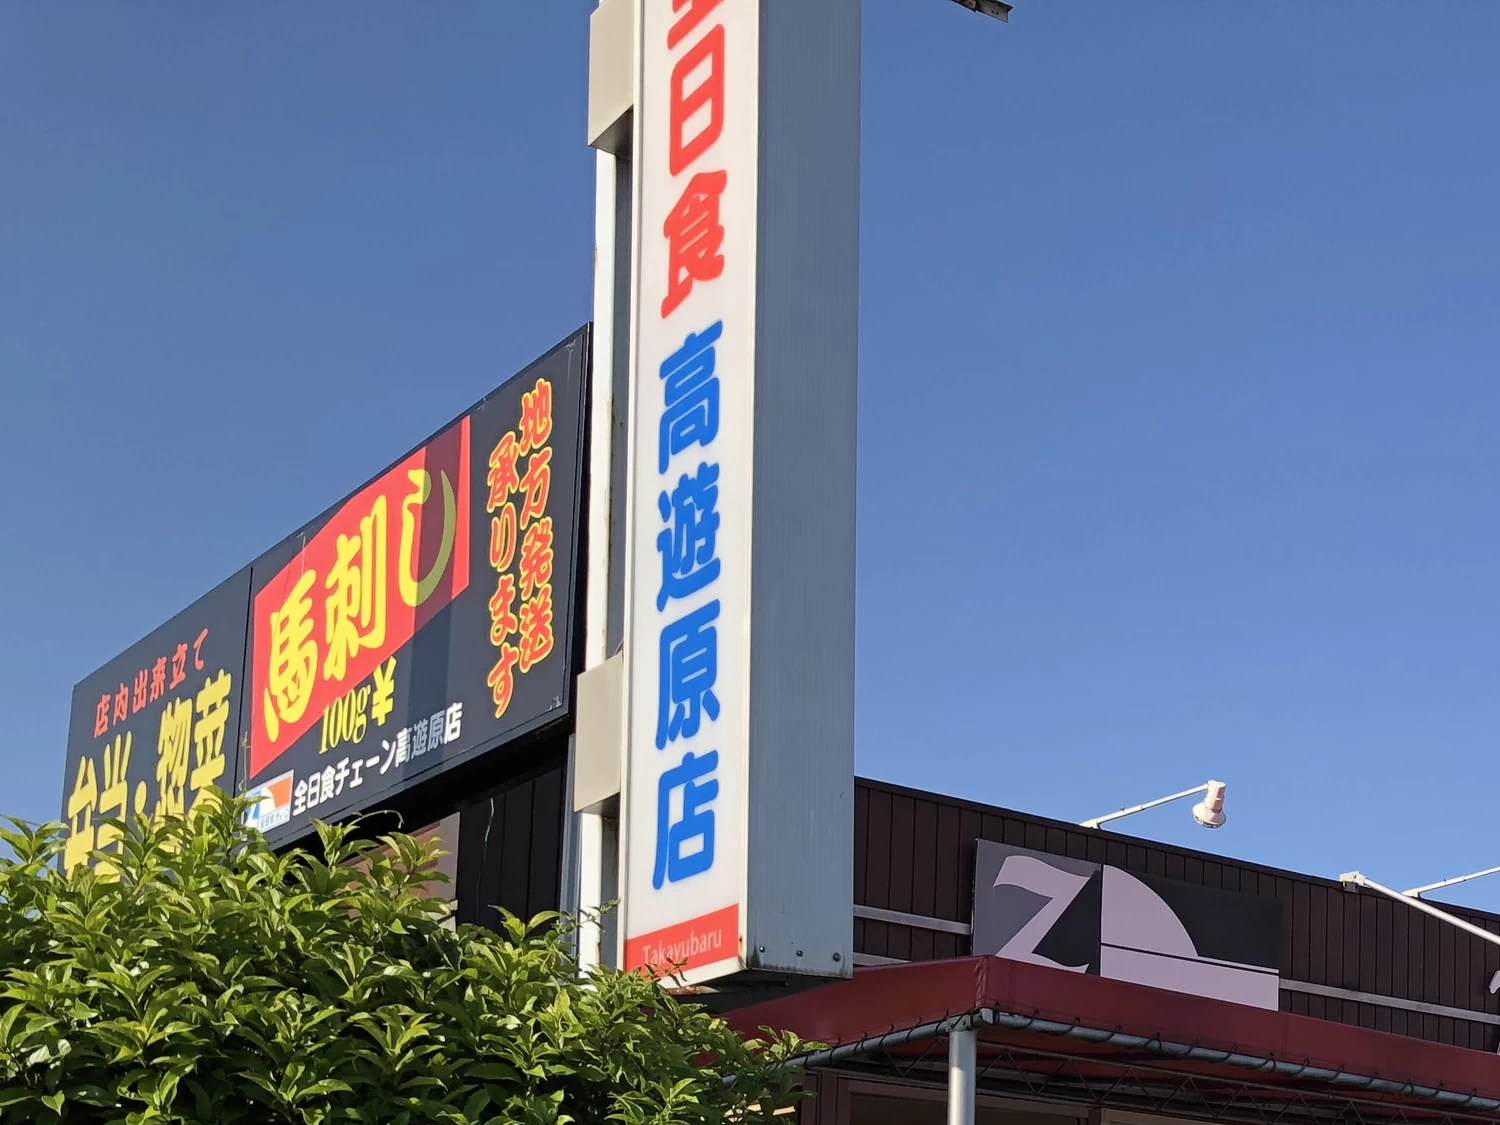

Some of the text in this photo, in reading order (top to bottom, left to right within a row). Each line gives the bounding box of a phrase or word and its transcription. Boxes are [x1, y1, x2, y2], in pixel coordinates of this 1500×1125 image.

[264, 468, 456, 743] 馬刺し
[485, 431, 518, 719] 承ります
[518, 377, 553, 671] 地方発送
[653, 320, 723, 890] 高遊原店
[94, 627, 209, 738] 店内出来立て
[642, 928, 723, 966] Takayubaru
